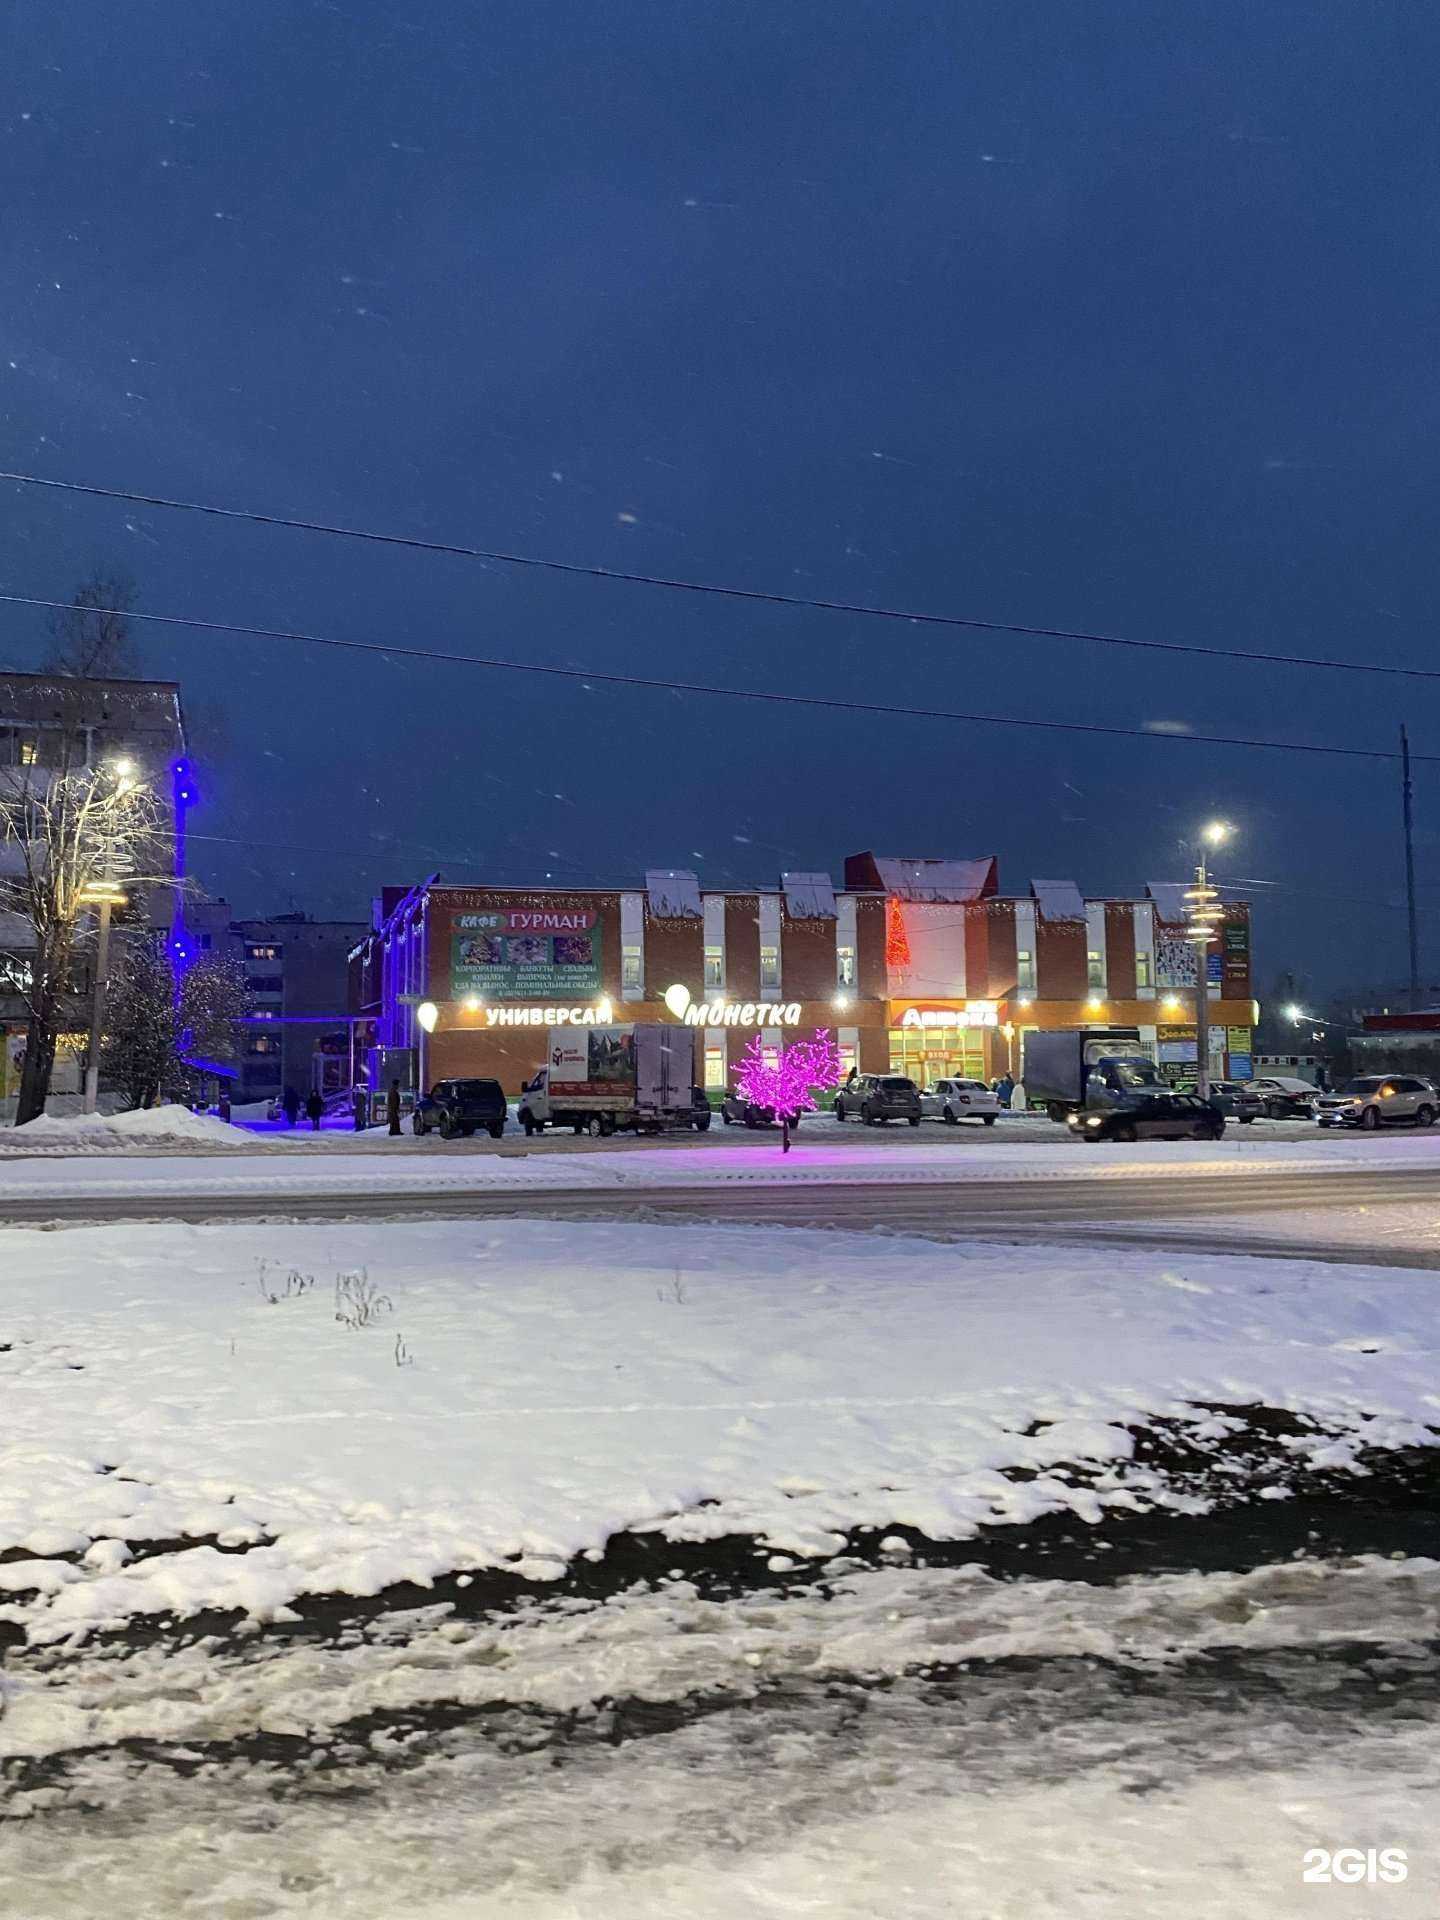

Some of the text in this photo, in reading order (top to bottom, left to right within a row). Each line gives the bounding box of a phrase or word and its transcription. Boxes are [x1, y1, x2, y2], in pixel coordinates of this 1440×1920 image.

[460, 914, 587, 928] КАФЕ ГУРМАН
[486, 1007, 613, 1026] УНИВЕРСАМ
